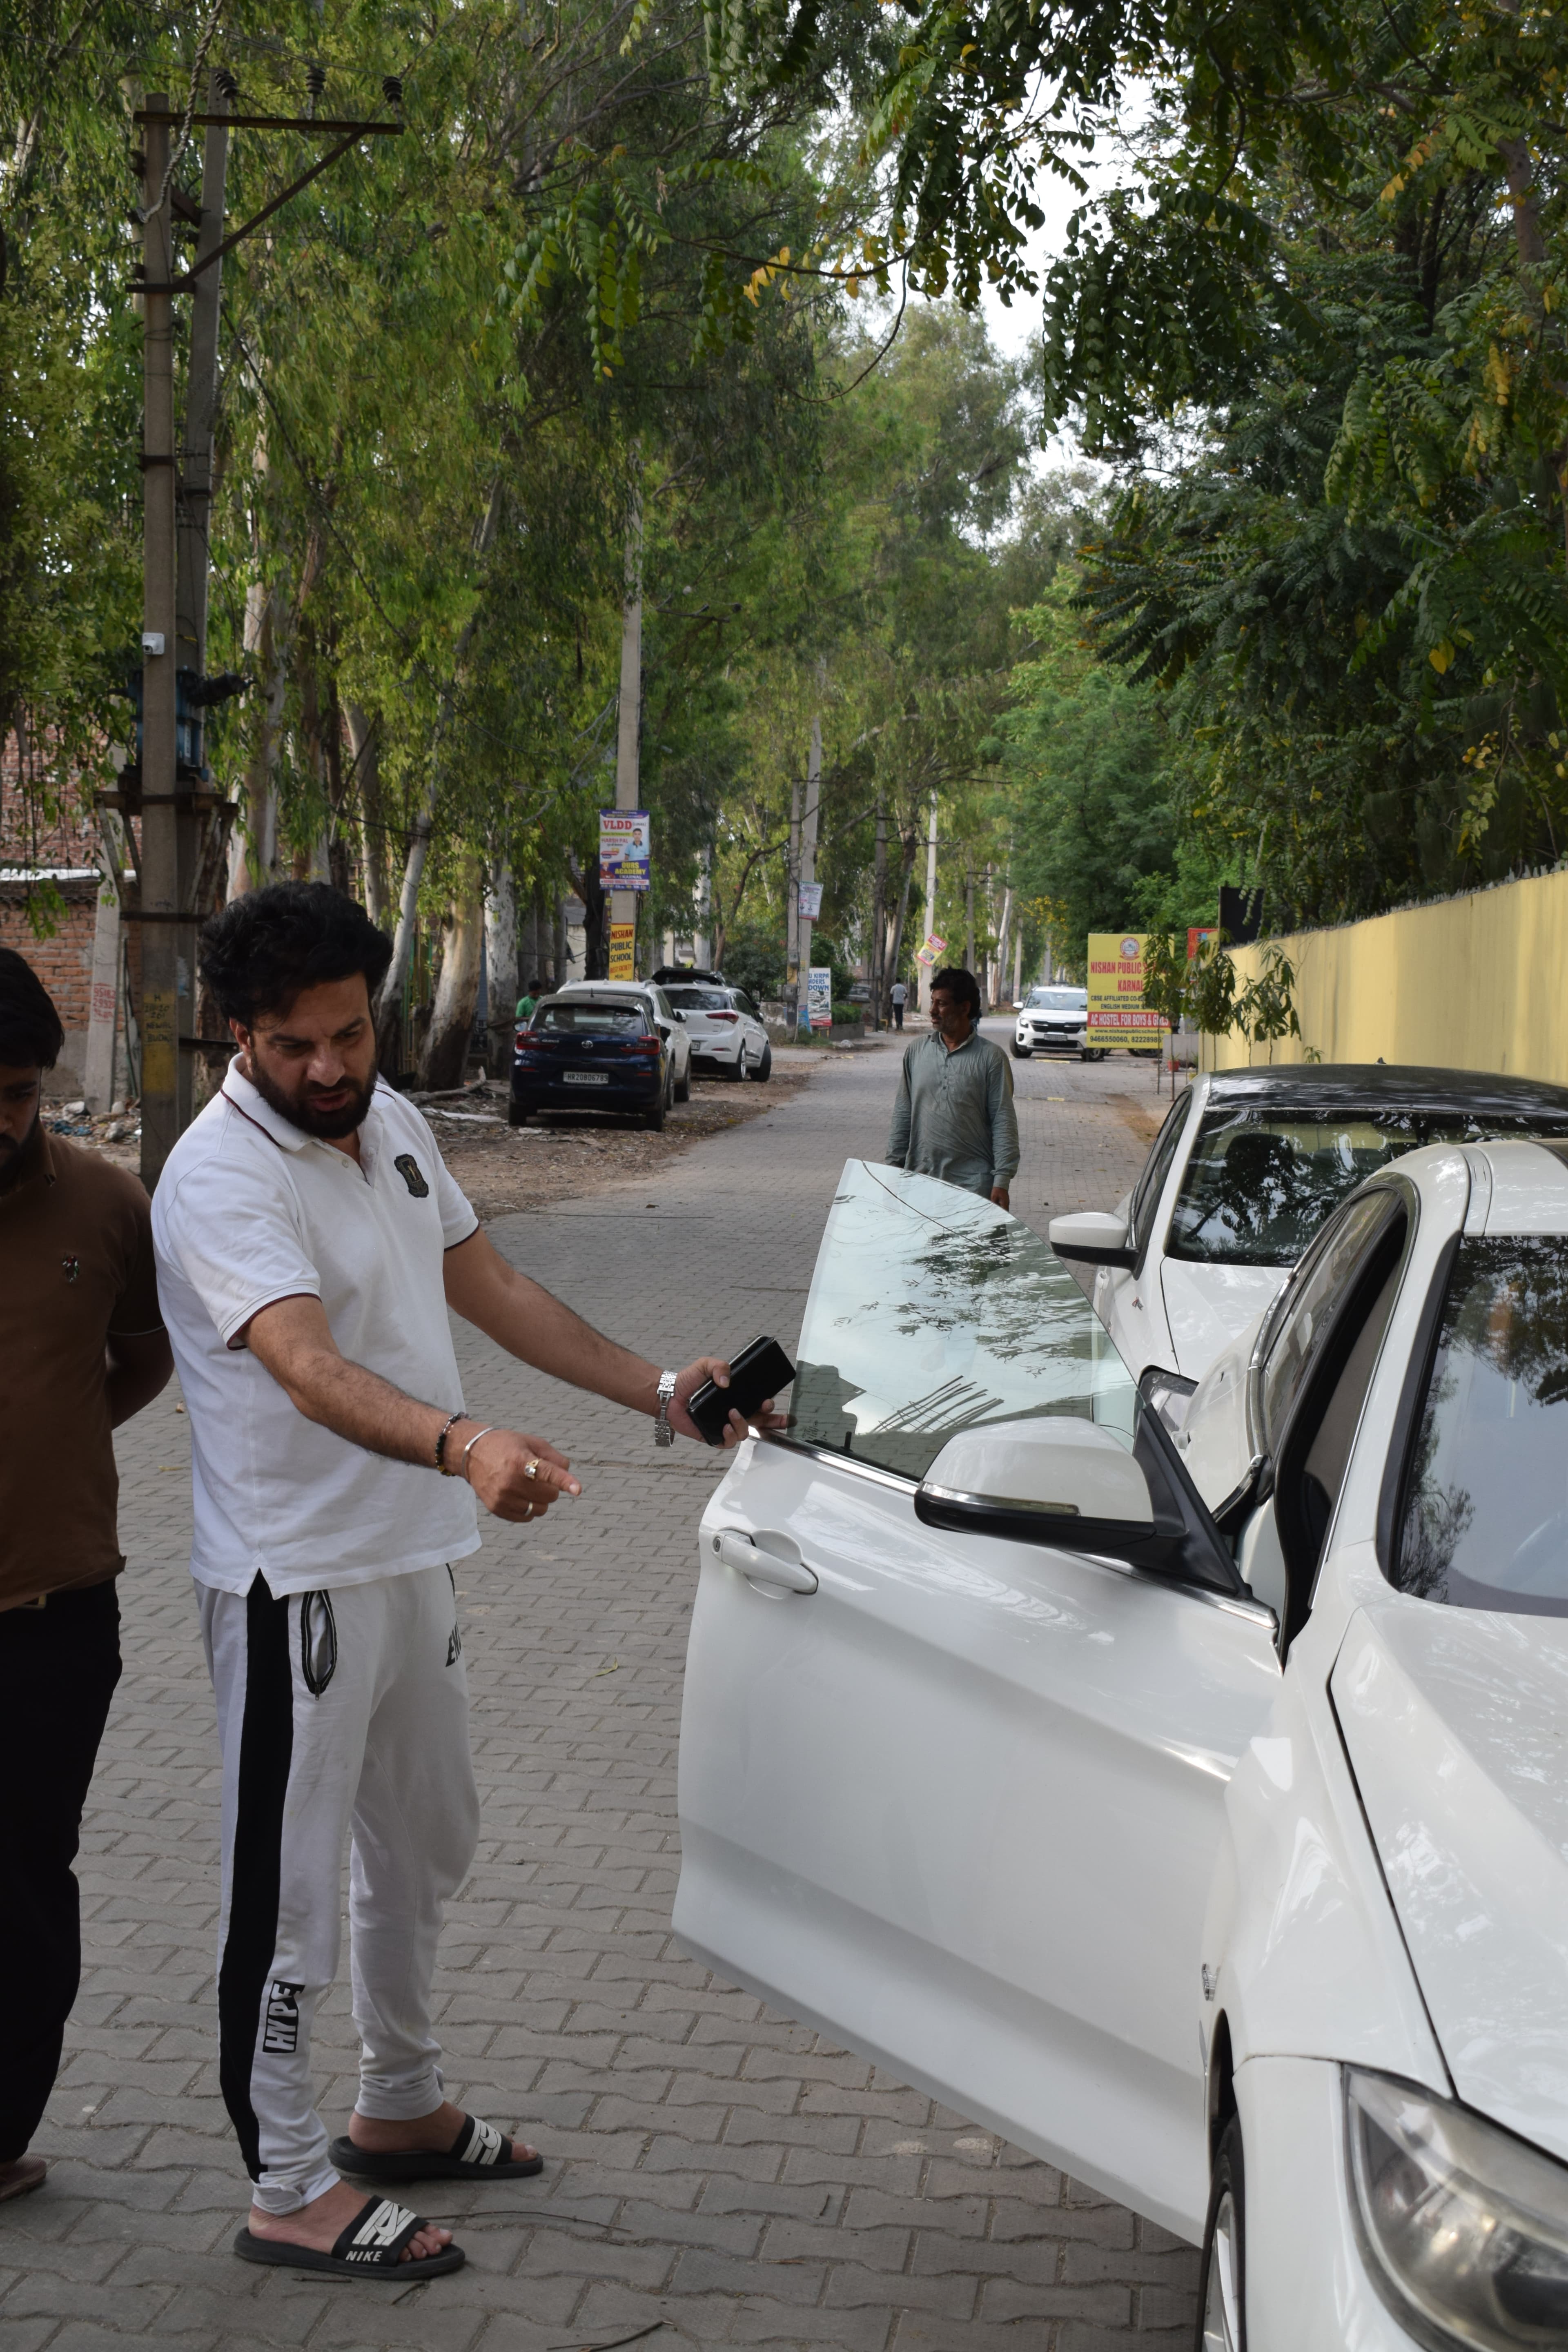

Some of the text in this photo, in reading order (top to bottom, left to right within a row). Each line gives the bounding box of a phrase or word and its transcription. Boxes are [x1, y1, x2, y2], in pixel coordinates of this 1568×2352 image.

[603, 820, 632, 830] VLDD
[611, 929, 633, 939] NISHAN
[611, 941, 632, 951] PUBLIC
[610, 953, 632, 962] SCHOOL
[1091, 962, 1116, 973] NISHAN
[1118, 962, 1141, 974] PUBLIC
[1118, 980, 1143, 992] KARNAL
[1091, 1014, 1098, 1025] AC
[1099, 1014, 1120, 1025] HOSTEL
[1121, 1014, 1131, 1026] FOR
[1132, 1014, 1147, 1026] BOYS
[1147, 1014, 1152, 1026] &
[265, 1983, 301, 2051] HYPE
[345, 2251, 382, 2261] NIKE
